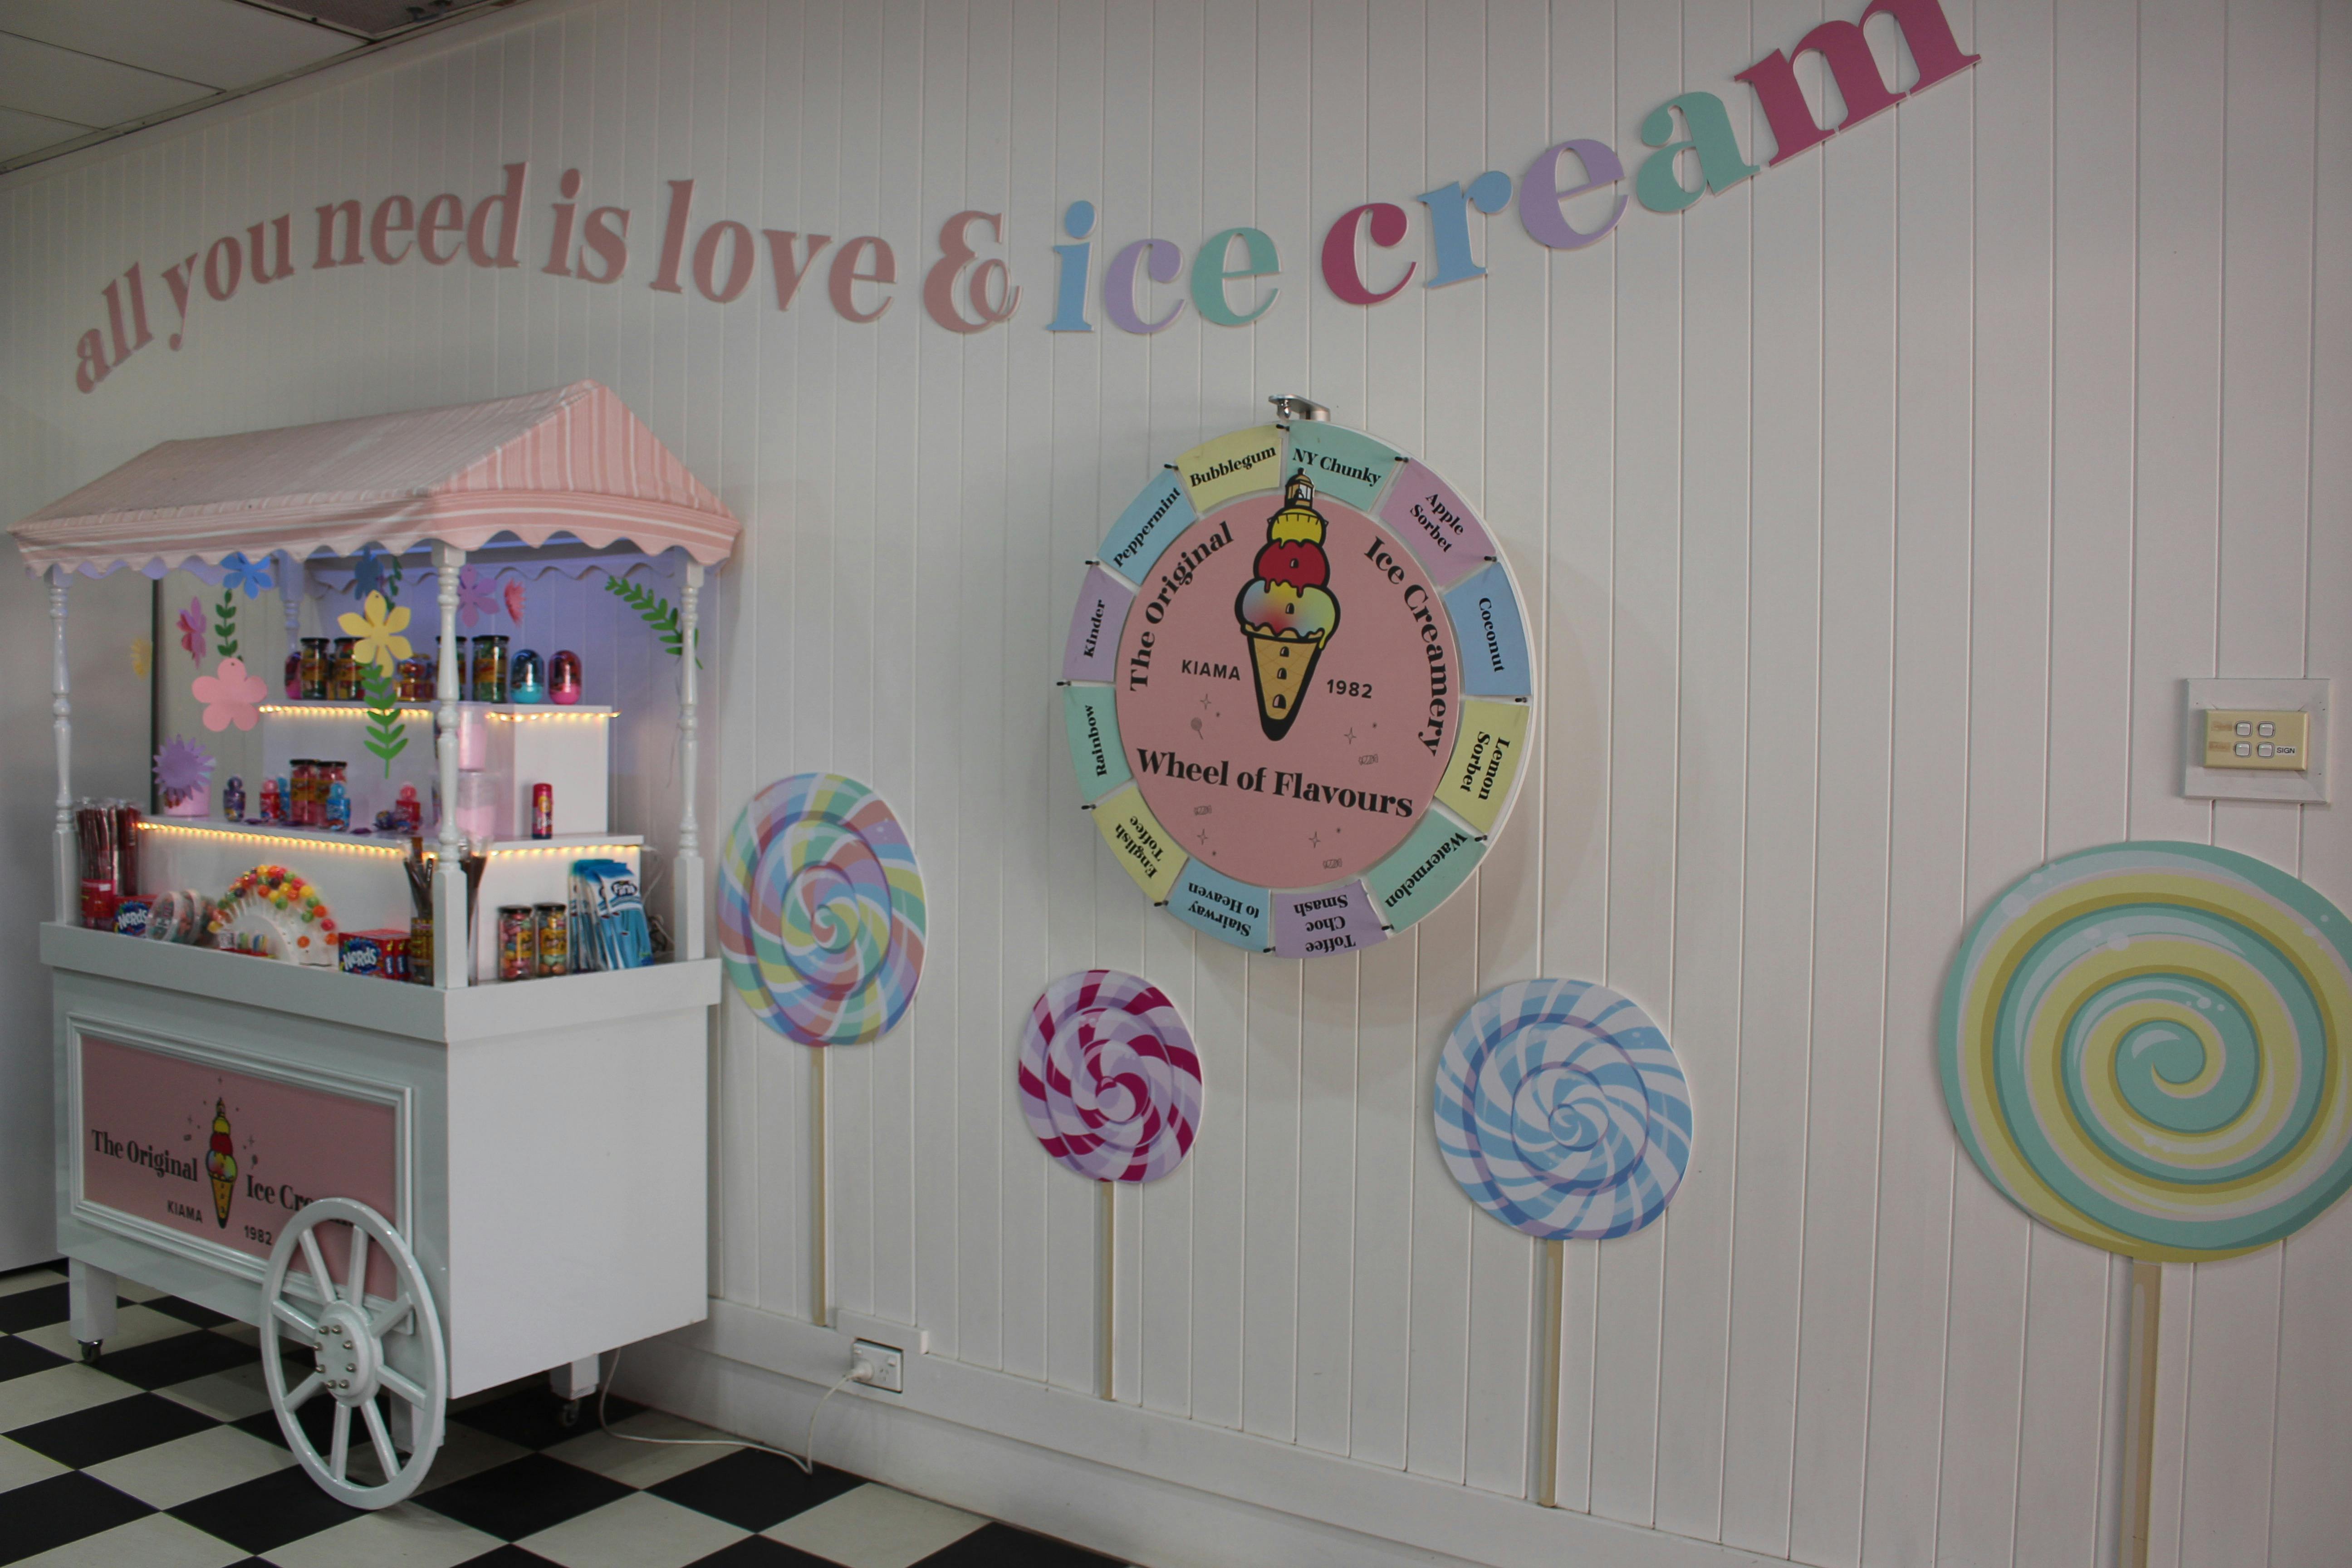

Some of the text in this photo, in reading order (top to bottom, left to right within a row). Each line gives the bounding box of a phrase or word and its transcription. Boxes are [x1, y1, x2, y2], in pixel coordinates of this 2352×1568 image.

[75, 0, 1982, 394] all you need is love & ice cream
[1191, 448, 1276, 486] Bubblegum
[1293, 448, 1382, 487] NY Chunky
[1114, 488, 1180, 567] Peppermint
[1410, 504, 1452, 553] Sorbet
[1426, 493, 1463, 536] Apple
[1084, 600, 1104, 657] Kinder
[1130, 520, 1234, 691] The Original
[1364, 536, 1447, 756] Ice Creamery
[1480, 598, 1504, 671] Coconut
[1182, 660, 1240, 680] KIAMA
[1328, 679, 1372, 698] 1982
[1086, 706, 1107, 776] Rainbow
[1460, 732, 1490, 791] Sorbet
[1137, 749, 1413, 818] Wheel of Flavours
[1478, 737, 1510, 800] Lemon
[1116, 823, 1157, 878] English
[1129, 816, 1162, 862] Toffee
[1385, 833, 1467, 907] Watermelon
[1189, 883, 1259, 918] to Heaven
[1189, 901, 1250, 936] Stairway
[1294, 895, 1348, 916] Smash
[1307, 916, 1345, 931] Choc
[1306, 935, 1356, 952] Toffee
[92, 1130, 197, 1181] The Original
[168, 1200, 202, 1222] KIAMA
[247, 1175, 274, 1204] Ice
[244, 1225, 272, 1246] 1982
